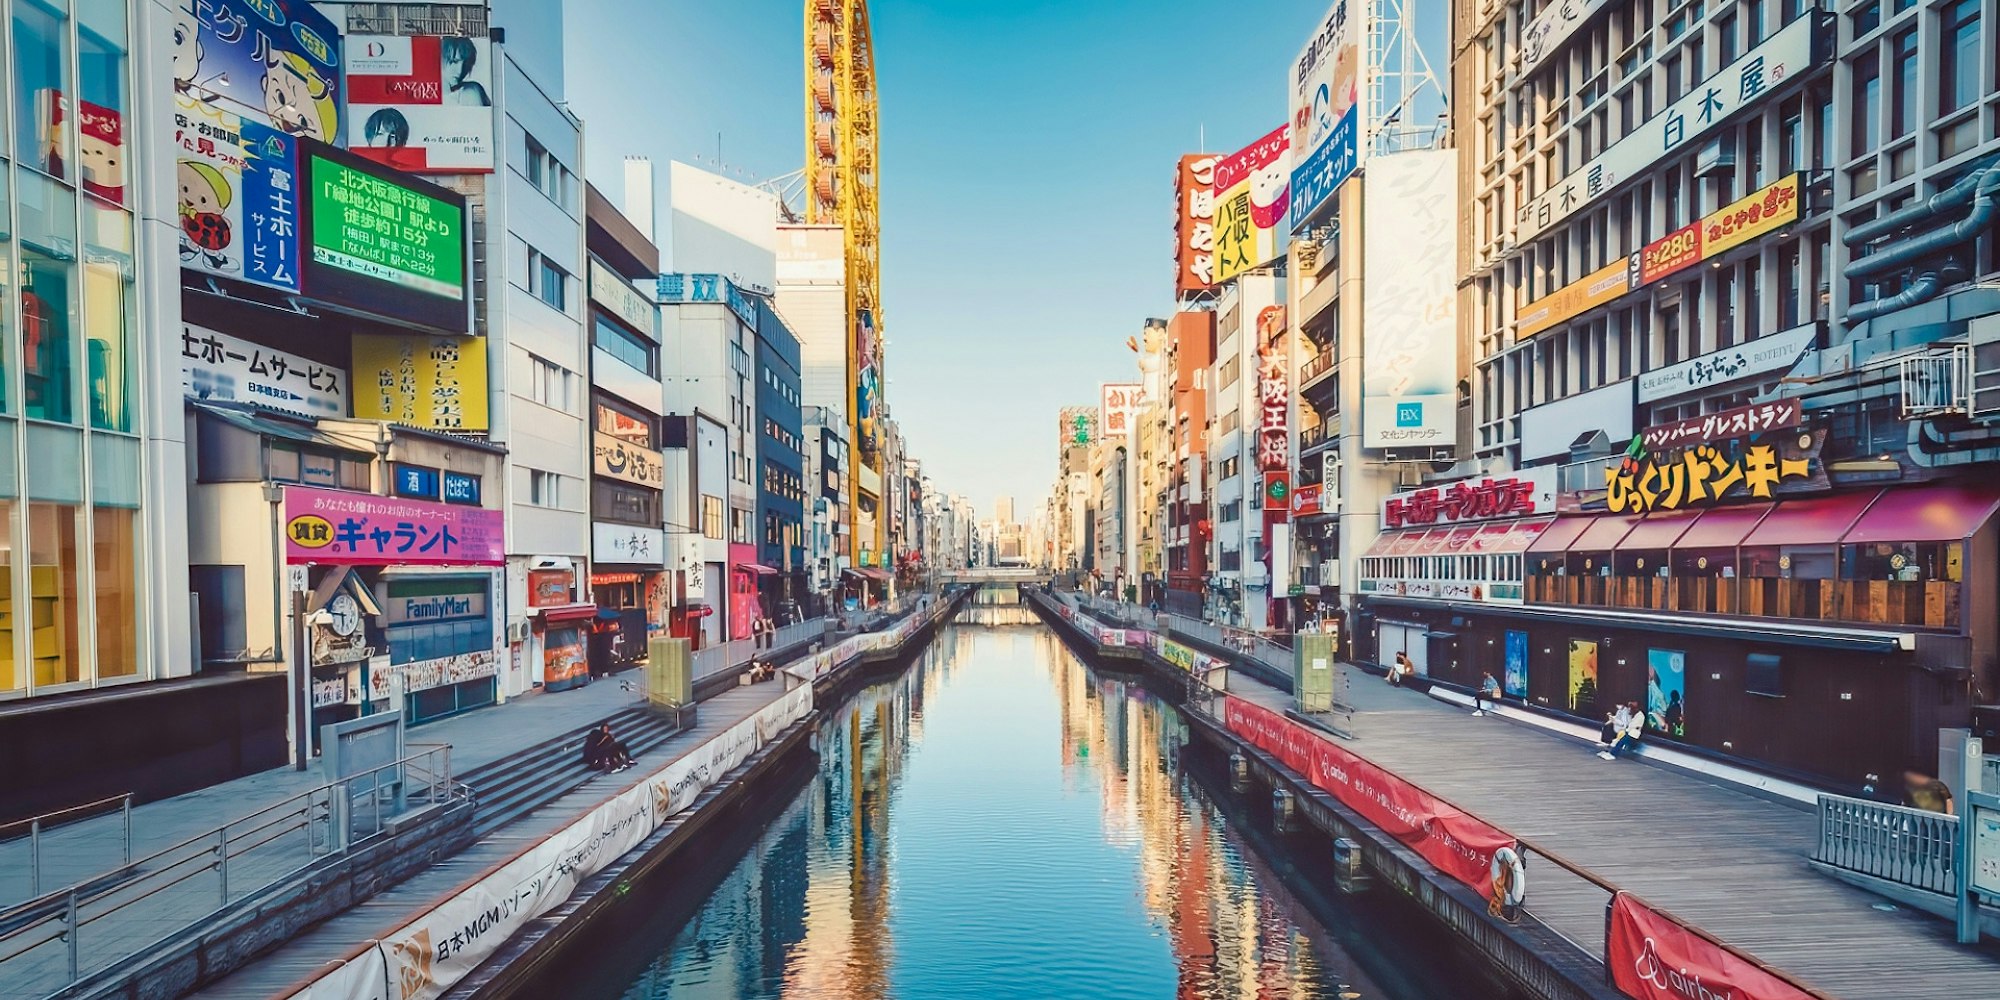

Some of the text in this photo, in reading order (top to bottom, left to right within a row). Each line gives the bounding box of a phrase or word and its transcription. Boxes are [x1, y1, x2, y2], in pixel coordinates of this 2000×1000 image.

[1662, 55, 1767, 151] 白木屋
[339, 169, 431, 214] 北大阪急行線
[1292, 140, 1354, 223] ガルフネット
[1520, 164, 1604, 229] 4F 白木屋
[251, 212, 269, 274] サービス
[269, 167, 295, 285] 富士ホーム
[1216, 199, 1234, 277] バイト
[1233, 190, 1250, 270] 高収入
[1258, 352, 1288, 467] 大阪王将
[1380, 428, 1442, 440] 文化シャッター
[1400, 409, 1419, 421] BX
[1643, 404, 1793, 446] ハンバーグレストラン
[407, 471, 419, 493] 酒
[445, 475, 470, 499] たばこ
[1605, 444, 1810, 514] びっくりドンキー
[331, 542, 341, 553] の
[336, 516, 459, 554] ギャラント
[406, 596, 471, 619] FamilyMart
[437, 877, 543, 964] 日本MGMリゾーツ
[1669, 967, 1731, 1000] airb
